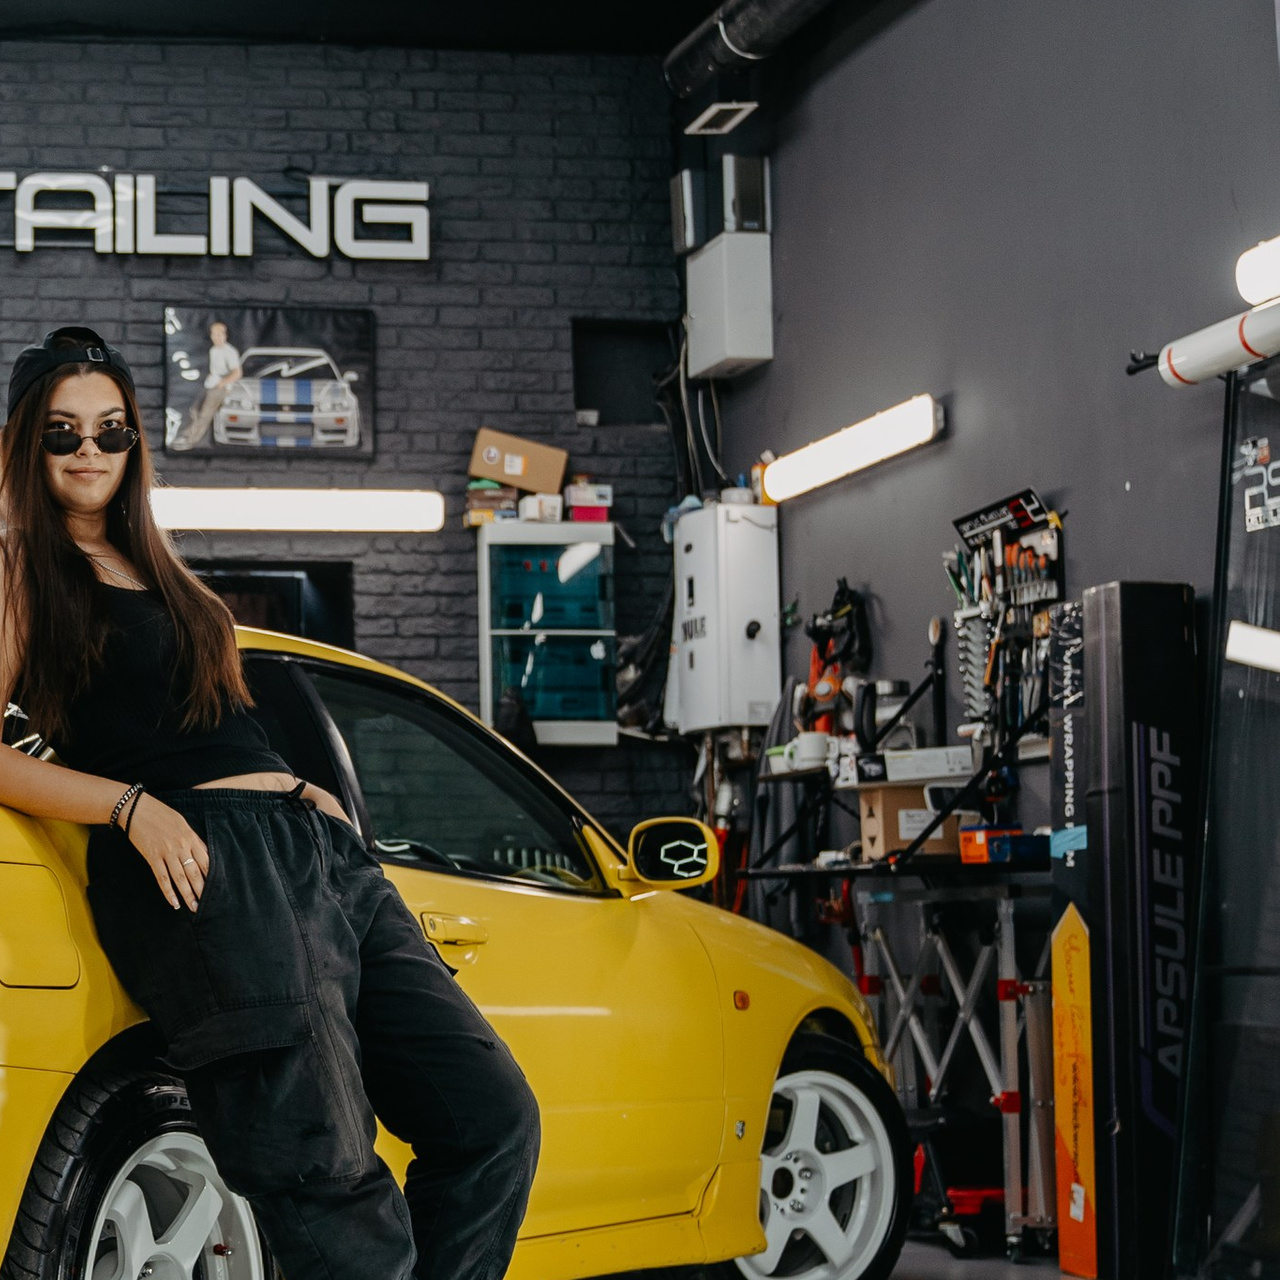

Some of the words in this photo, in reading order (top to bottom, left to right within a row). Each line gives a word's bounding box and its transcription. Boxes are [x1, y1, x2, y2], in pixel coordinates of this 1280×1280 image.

[1063, 713, 1075, 818] WRAPPING
[1149, 726, 1183, 841] PPF
[1065, 822, 1075, 867] FM
